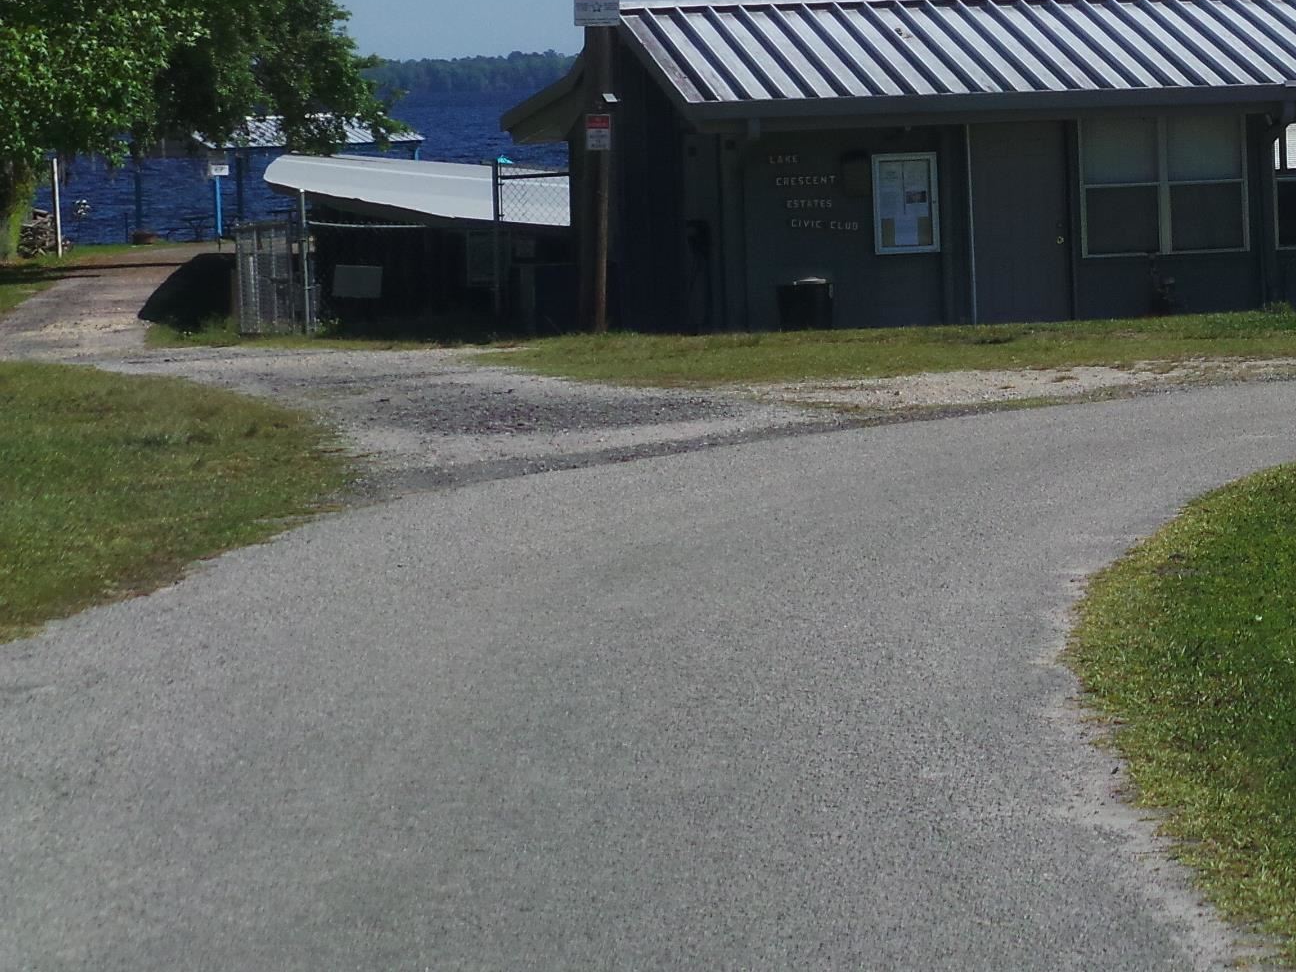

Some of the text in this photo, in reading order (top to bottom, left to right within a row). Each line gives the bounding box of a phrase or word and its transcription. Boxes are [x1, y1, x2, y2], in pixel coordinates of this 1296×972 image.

[769, 155, 799, 164] LAKE
[776, 175, 836, 186] CRESCENT
[786, 199, 832, 209] ESTATES
[791, 218, 858, 230] CIVIC CLUB
